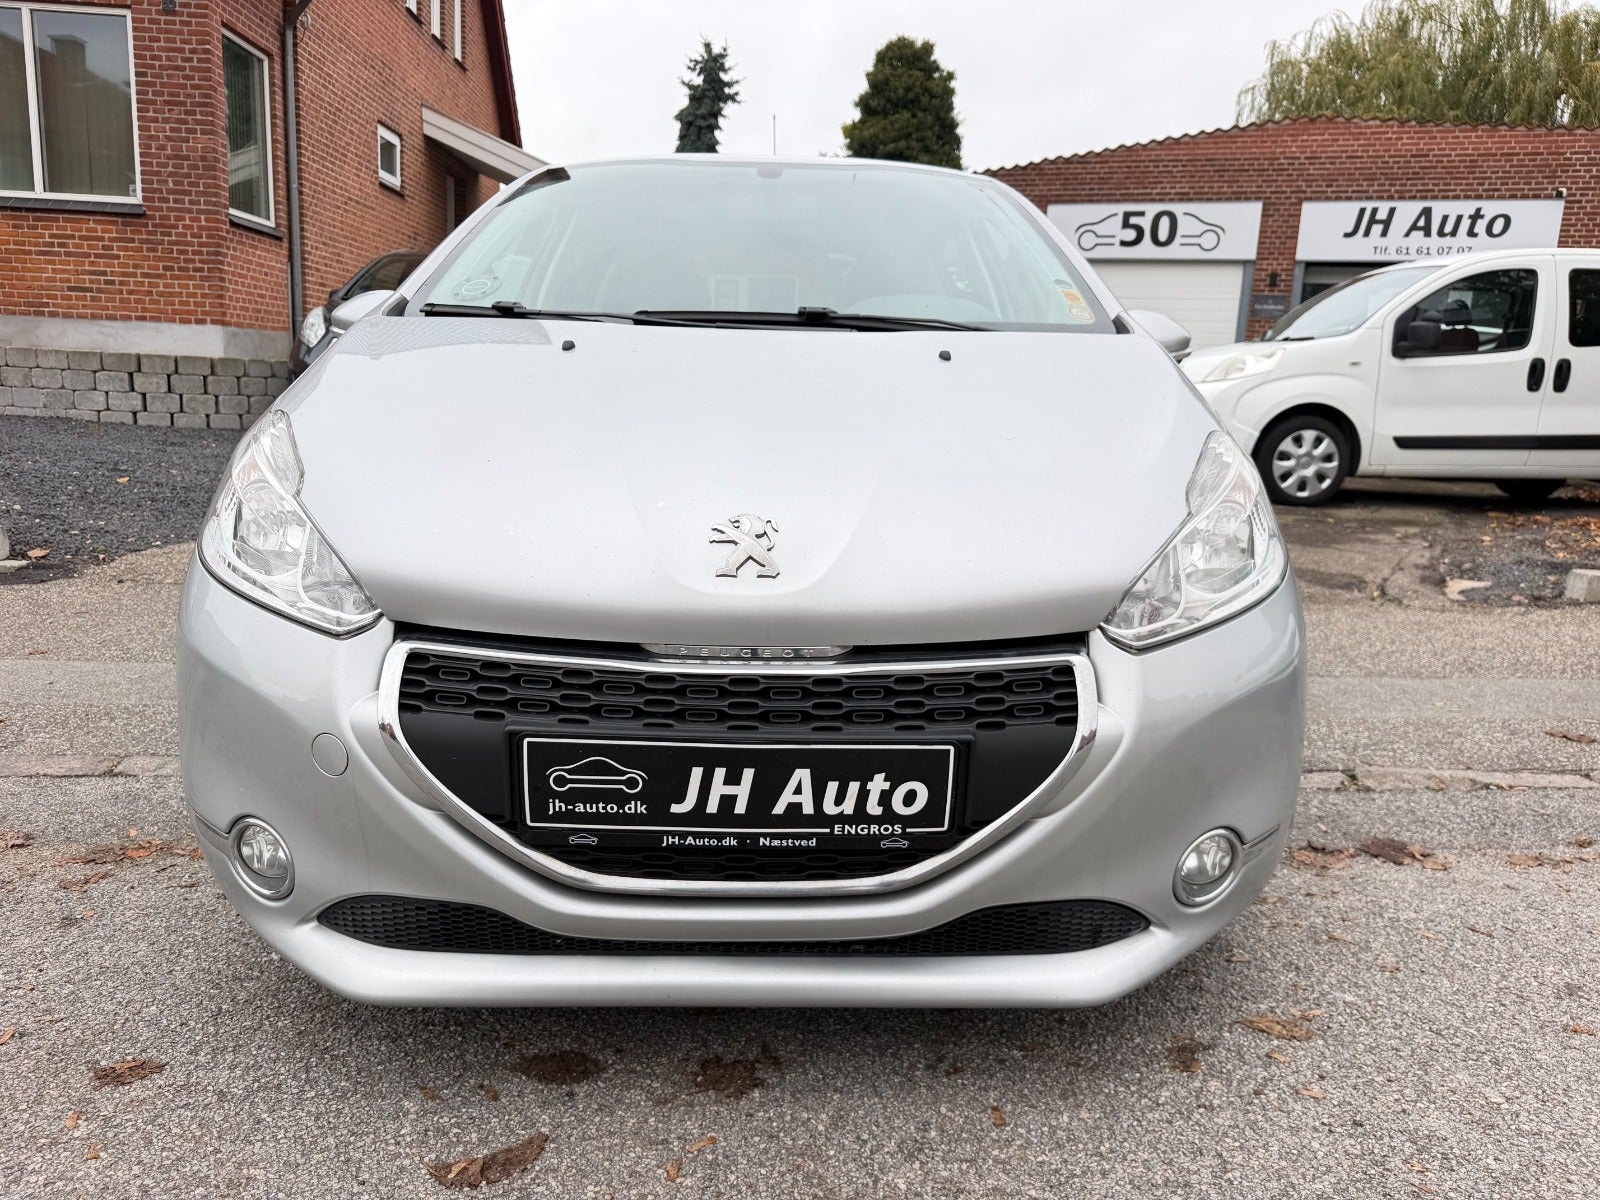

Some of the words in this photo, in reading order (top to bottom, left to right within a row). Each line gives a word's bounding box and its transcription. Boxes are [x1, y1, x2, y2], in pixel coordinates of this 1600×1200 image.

[1119, 209, 1179, 248] 50
[1342, 206, 1397, 238] JH
[1403, 206, 1512, 238] Auto
[1373, 246, 1391, 256] Tlf.
[1395, 246, 1411, 256] 61
[1416, 246, 1432, 256] 61
[1437, 246, 1453, 255] 07
[669, 766, 756, 815] JH
[771, 768, 929, 816] Auto
[548, 798, 648, 815] jh-auto.dk
[834, 824, 903, 836] ENGROS
[662, 836, 738, 847] JH-Auto.dk
[759, 836, 817, 847] Næstved
